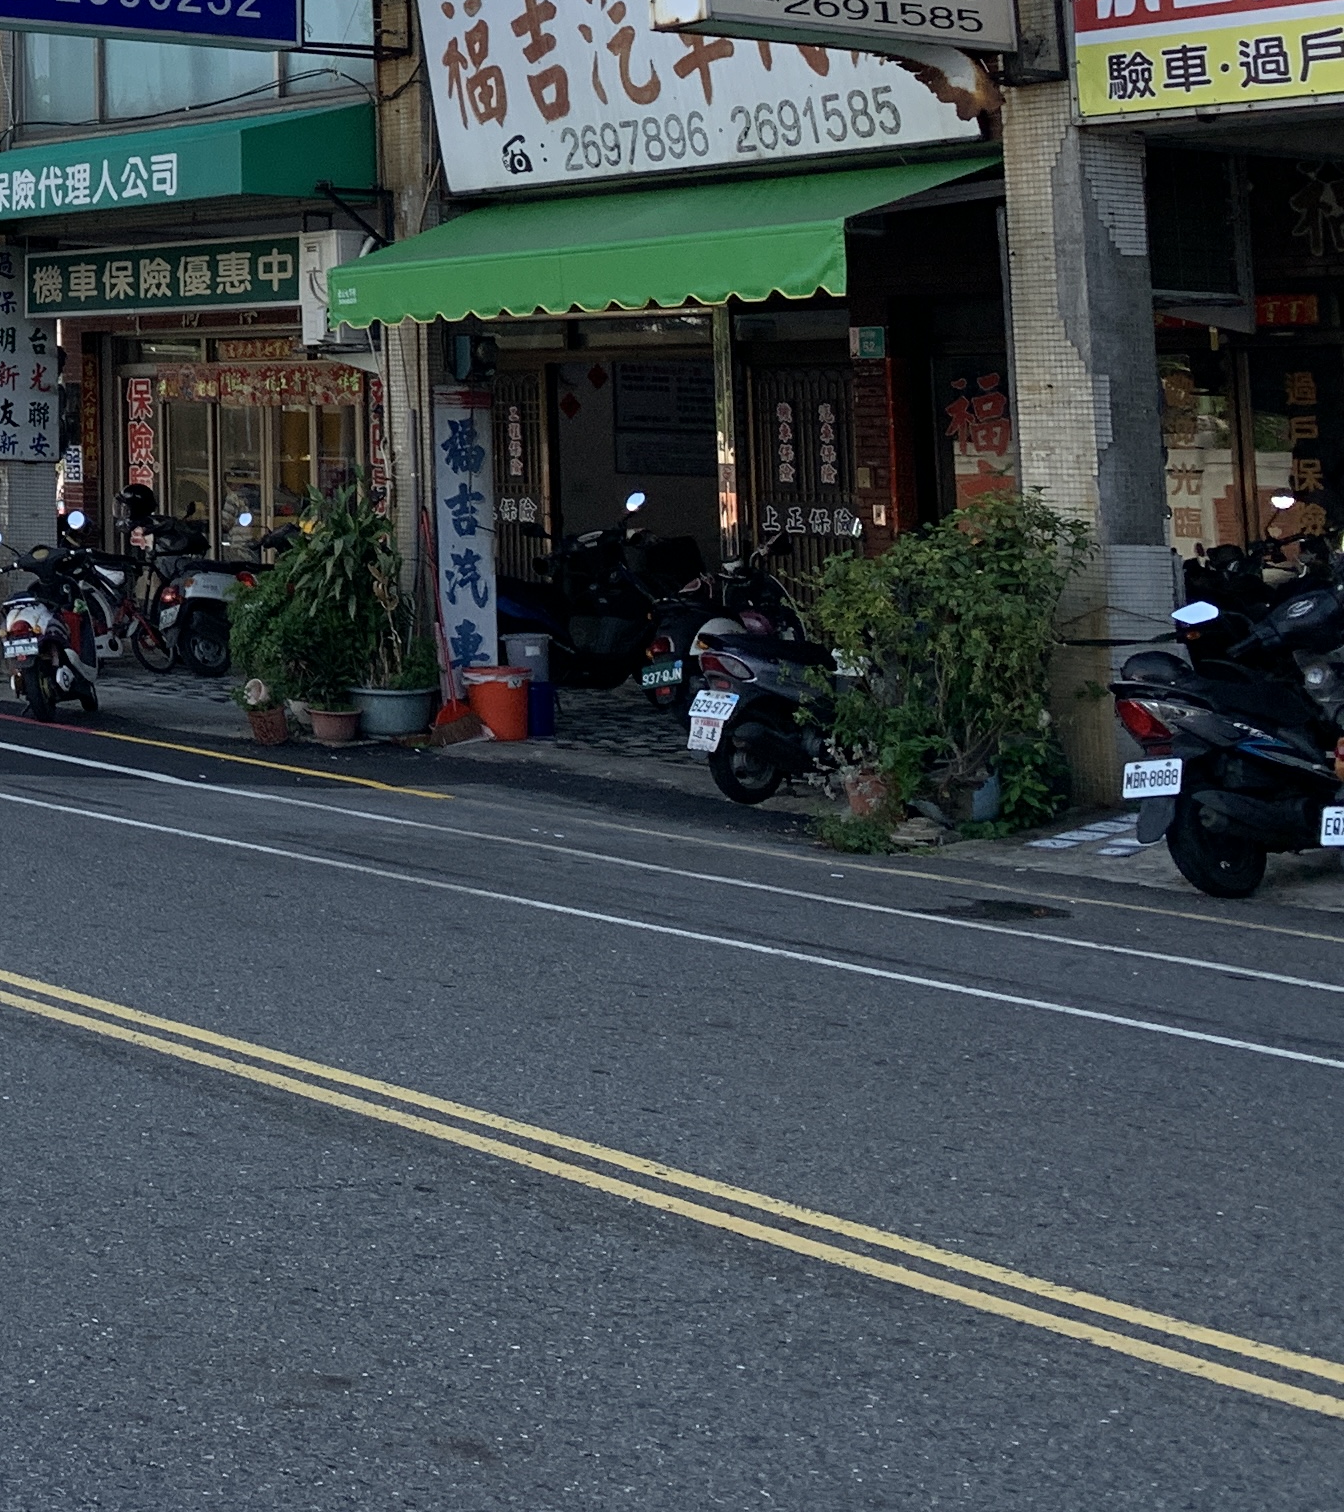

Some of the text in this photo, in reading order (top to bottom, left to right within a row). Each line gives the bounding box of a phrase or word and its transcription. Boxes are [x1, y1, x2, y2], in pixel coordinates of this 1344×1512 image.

[561, 85, 902, 172] 2697896 2691585
[31, 247, 294, 304] 機車保險優惠中
[440, 418, 490, 670] 福吉汽車
[762, 504, 857, 536] 上正保險
[1125, 768, 1179, 790] MBR-8888
